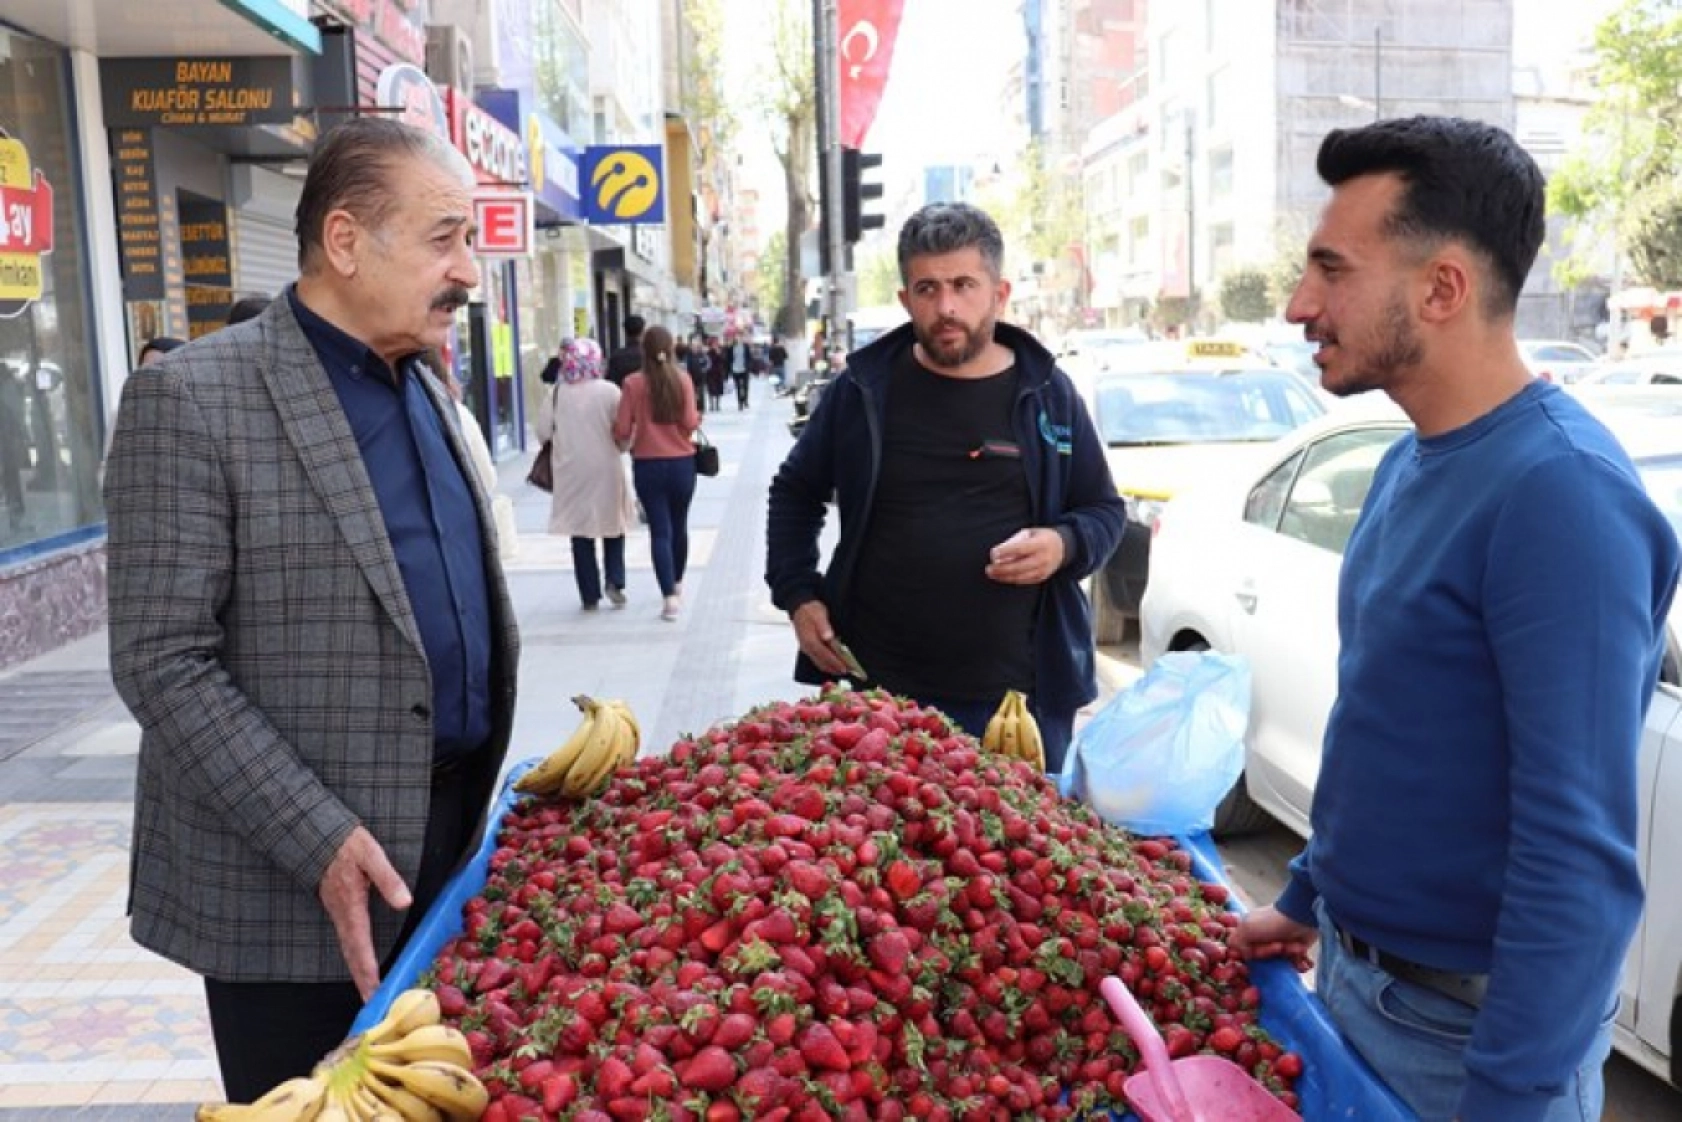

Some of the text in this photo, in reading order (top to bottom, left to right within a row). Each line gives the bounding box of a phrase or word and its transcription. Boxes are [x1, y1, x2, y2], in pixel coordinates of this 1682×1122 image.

[176, 61, 231, 82] BAYAN
[132, 85, 272, 110] KUAFÖR SALONU
[485, 205, 517, 245] E
